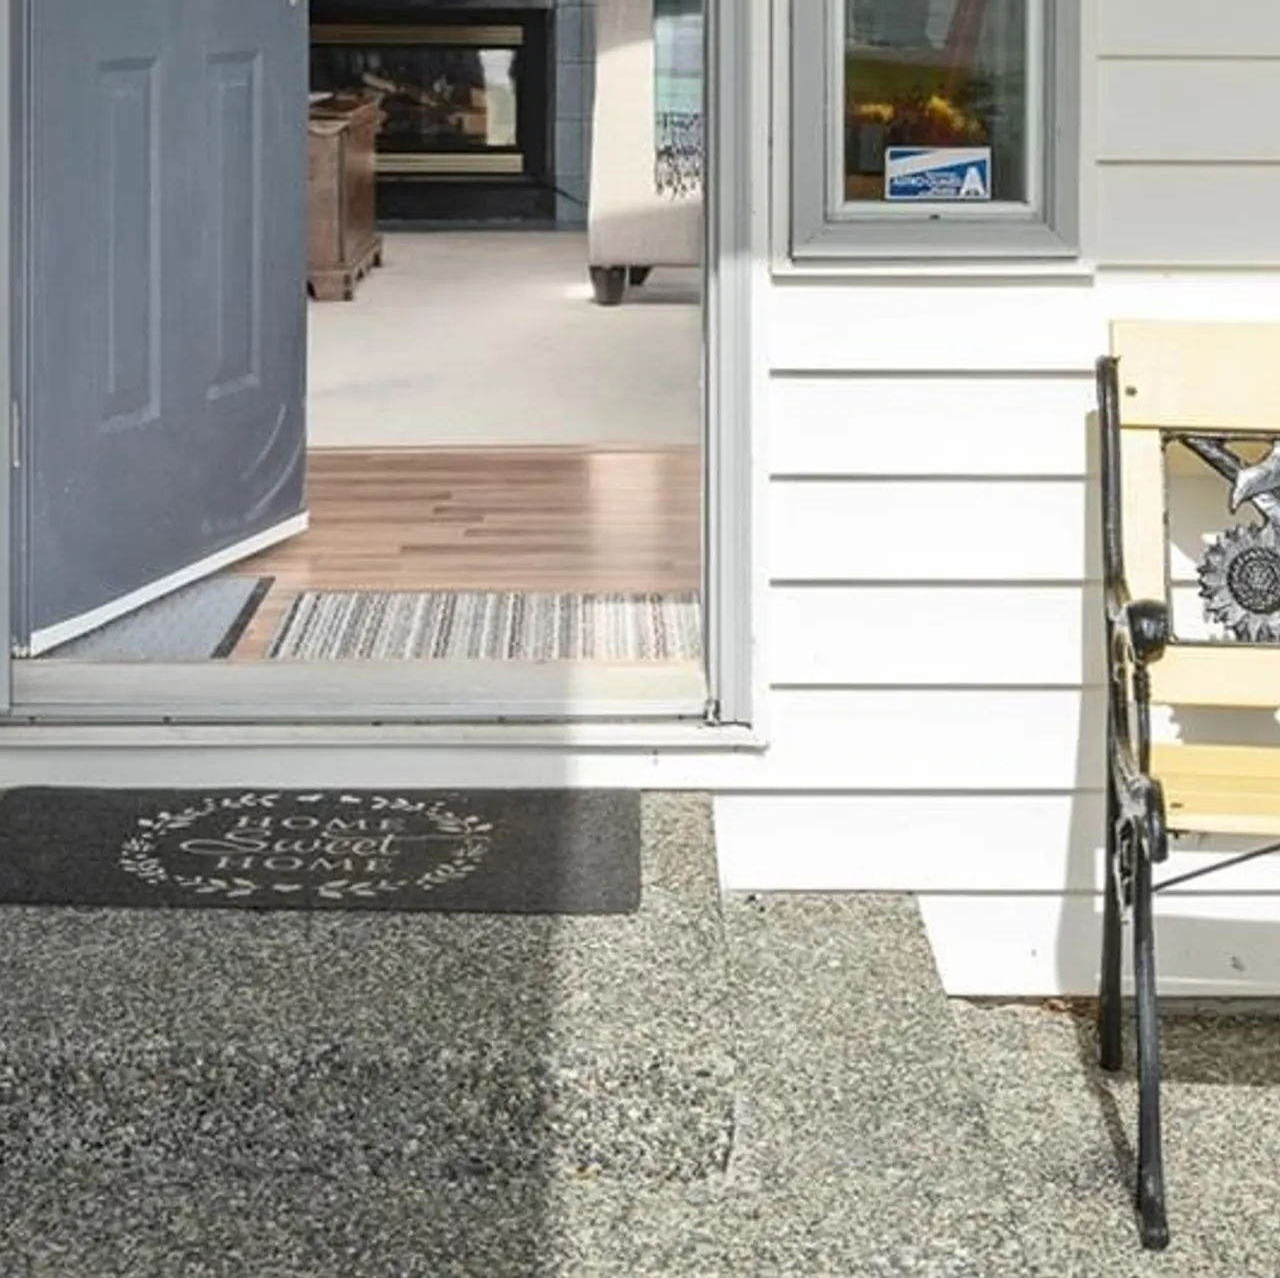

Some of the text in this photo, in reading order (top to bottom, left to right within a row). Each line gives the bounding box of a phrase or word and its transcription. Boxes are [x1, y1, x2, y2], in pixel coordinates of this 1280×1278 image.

[236, 815, 405, 831] HOME
[179, 827, 402, 855] Sweet
[216, 855, 393, 872] HOME
